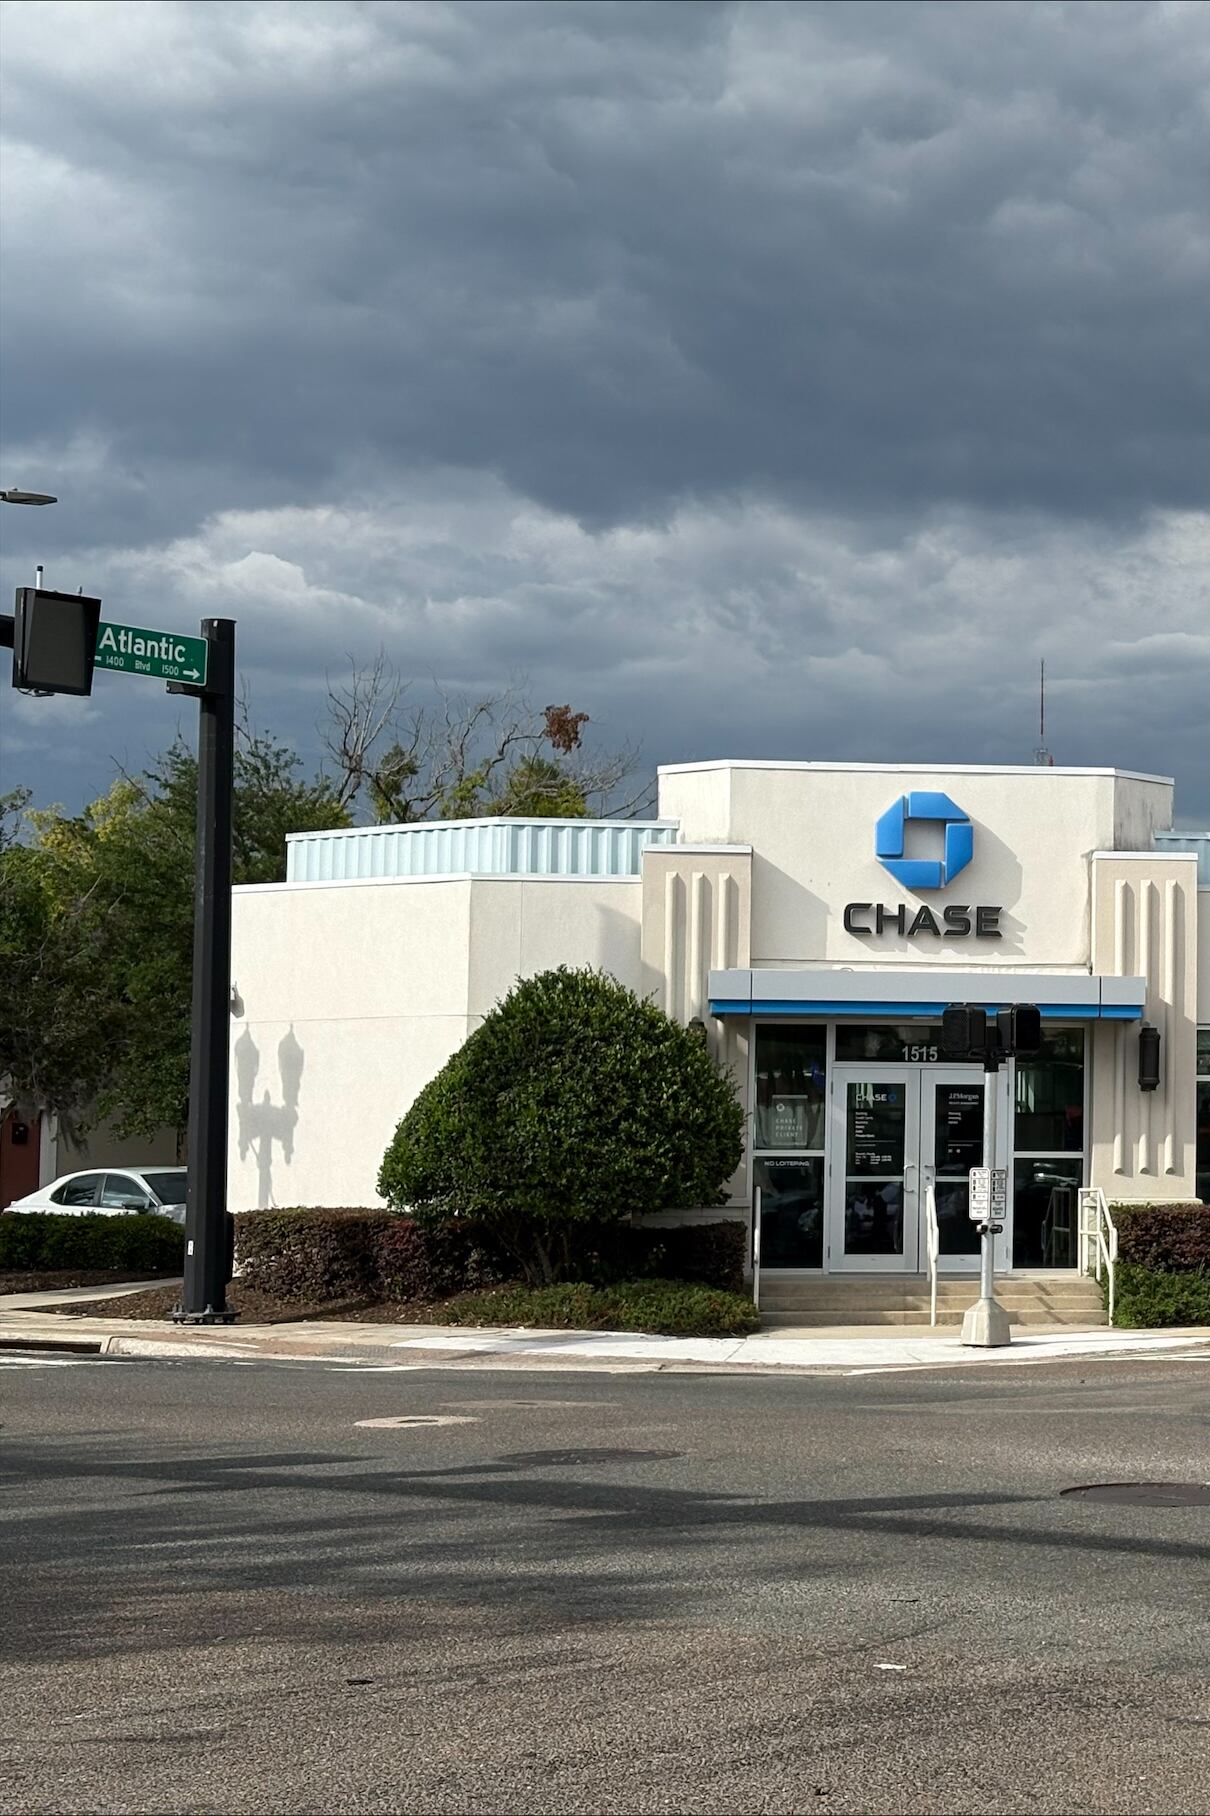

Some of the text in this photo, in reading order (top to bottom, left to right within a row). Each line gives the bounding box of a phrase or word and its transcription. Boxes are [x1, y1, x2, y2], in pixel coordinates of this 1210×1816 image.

[98, 626, 187, 663] Atlantic
[105, 655, 179, 676] 1400 Blvd 1500
[843, 902, 1003, 938] CHASE
[902, 1045, 938, 1062] 1515
[855, 1093, 888, 1102] CHASE
